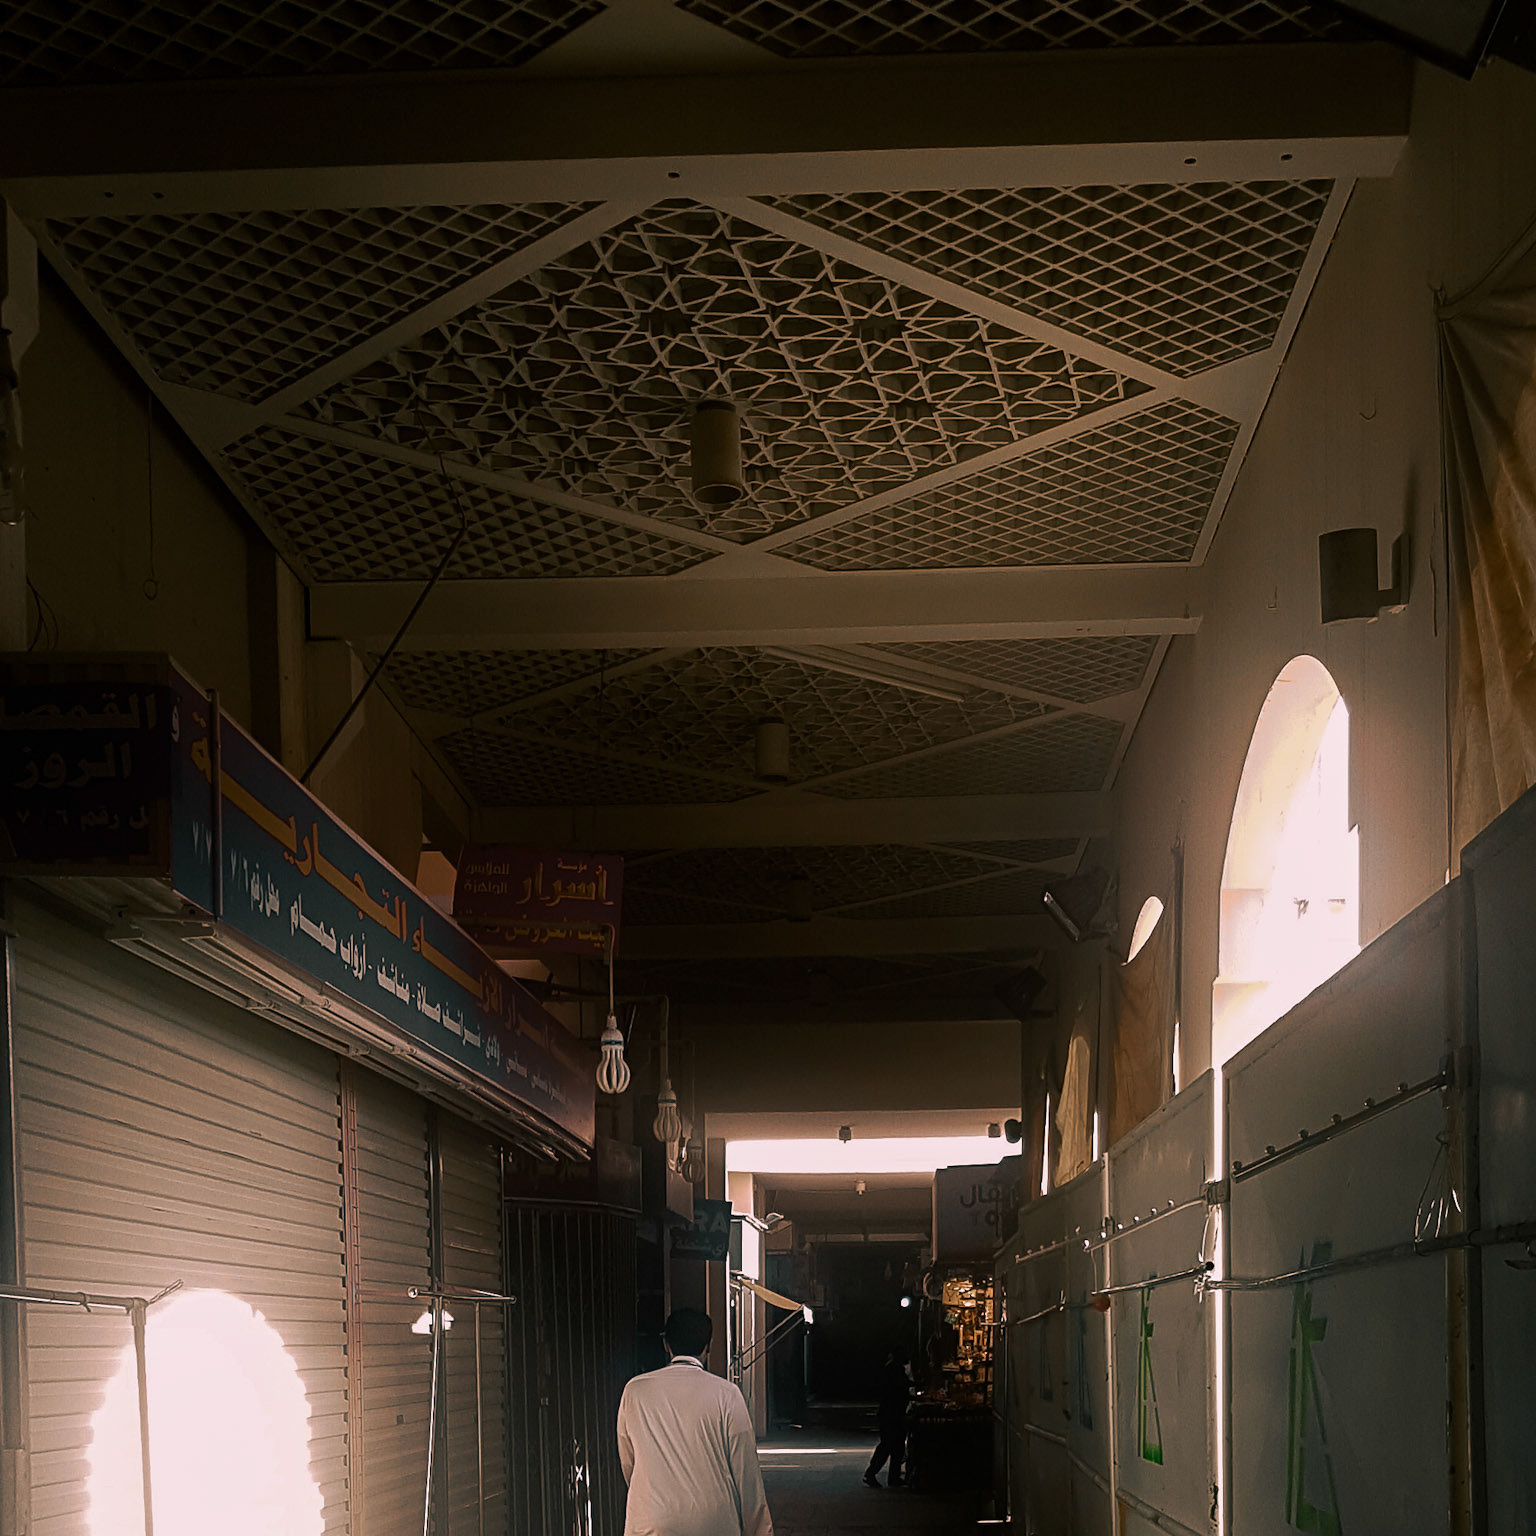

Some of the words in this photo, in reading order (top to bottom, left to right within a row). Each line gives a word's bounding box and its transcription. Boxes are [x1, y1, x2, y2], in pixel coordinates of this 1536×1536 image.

[0, 685, 158, 734] القمصا
[191, 711, 407, 943] التجارية
[250, 861, 264, 912] رقم
[265, 871, 280, 918] محل
[515, 862, 615, 907] أسرار
[289, 892, 337, 955] حمام
[339, 931, 367, 982] أرواب
[376, 956, 411, 1006] مناشف
